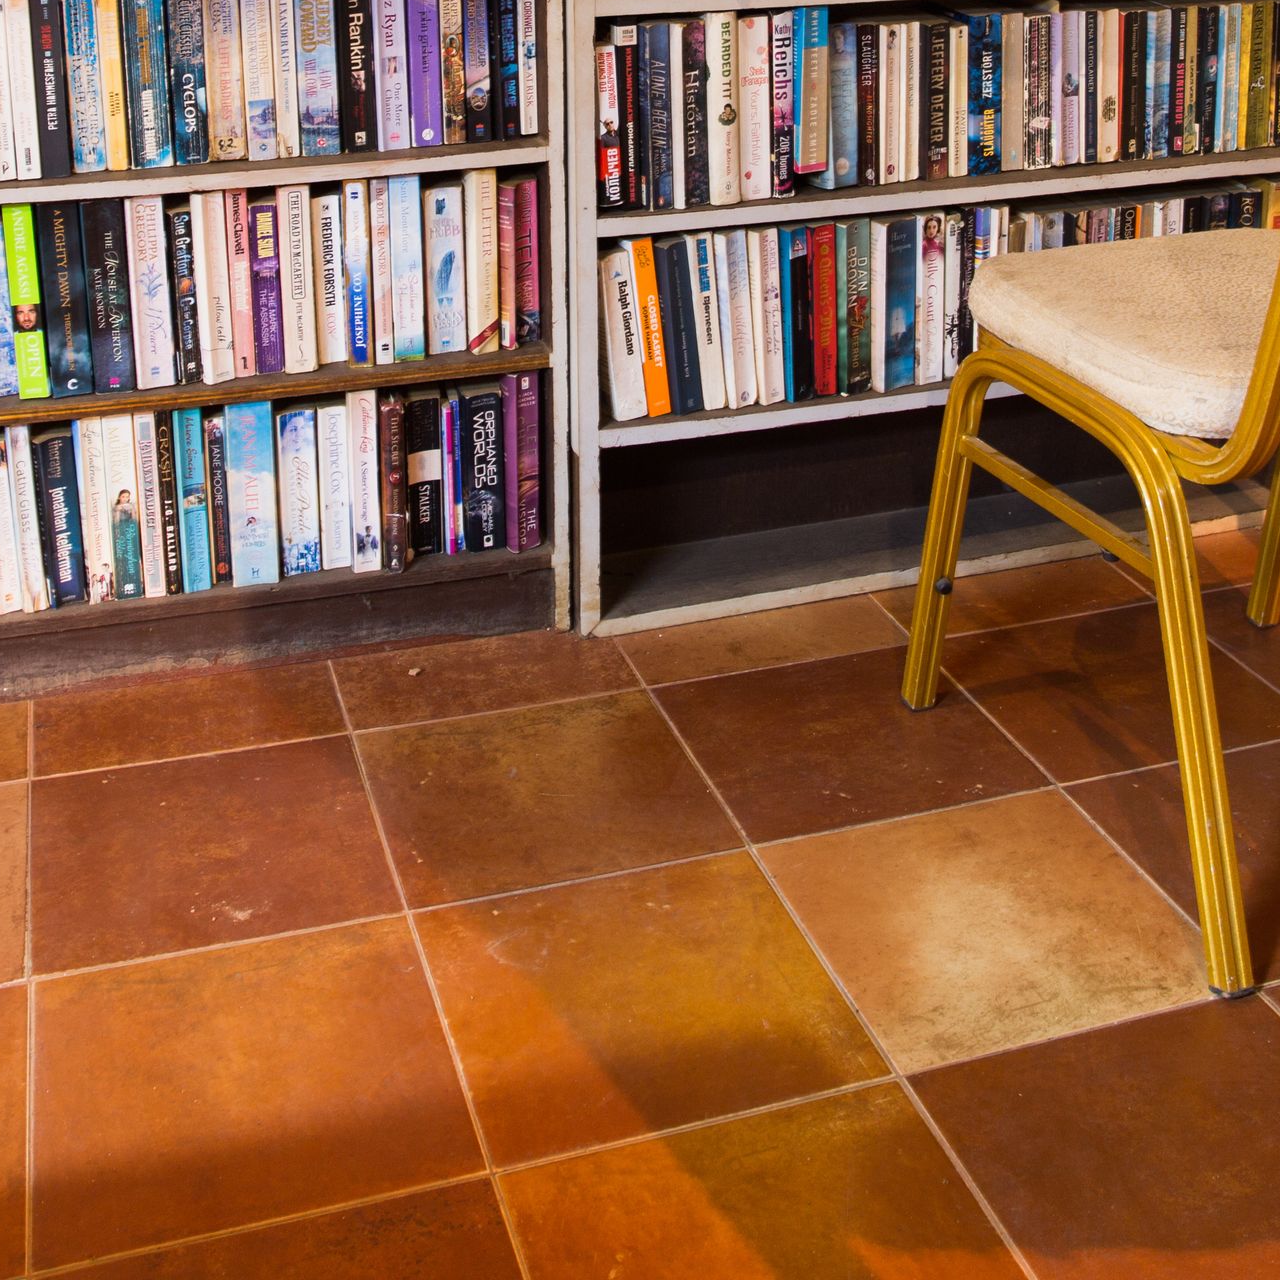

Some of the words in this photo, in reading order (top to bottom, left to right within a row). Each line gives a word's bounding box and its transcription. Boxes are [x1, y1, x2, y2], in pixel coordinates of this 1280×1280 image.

[349, 12, 365, 71] Rankin
[382, 13, 397, 47] Ryan
[721, 21, 731, 78] BEARDED
[722, 80, 731, 100] TIT
[774, 37, 791, 101] Reichs
[982, 51, 993, 99] ZERSTÖRT
[182, 73, 197, 133] CYCLOPS
[685, 69, 699, 158] Historian
[609, 148, 620, 201] КОЛЫЧЕВ
[321, 216, 335, 267] FREDERICK
[324, 269, 335, 307] FORSYTH
[618, 280, 628, 311] Ralph
[847, 246, 857, 308] BROWN
[857, 257, 867, 292] DAN
[621, 311, 634, 356] Giordano
[647, 294, 658, 331] CLOSED
[26, 335, 40, 378] OPEN
[651, 332, 663, 368] CASKET
[158, 426, 171, 482] CRASH
[473, 412, 486, 489] WORLDS
[484, 410, 497, 486] ORPHANED
[419, 485, 430, 524] STALKER
